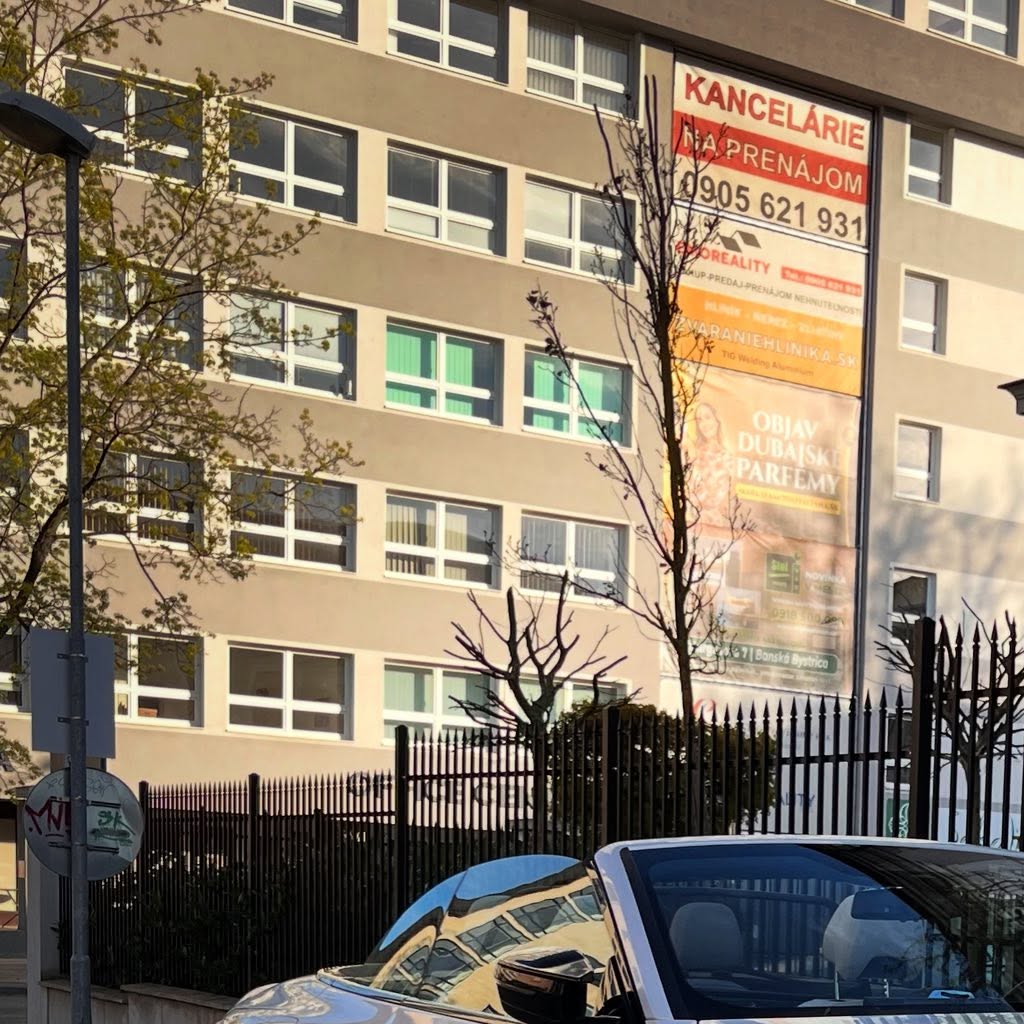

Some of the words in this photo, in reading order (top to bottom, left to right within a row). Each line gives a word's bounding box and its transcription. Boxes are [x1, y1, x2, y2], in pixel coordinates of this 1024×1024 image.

[685, 72, 864, 150] KANCELÁRIE
[727, 141, 862, 195] PRENÁJOM
[683, 171, 750, 212] 0905
[760, 192, 804, 227] 621
[818, 207, 862, 241] 931
[752, 410, 819, 440] OBJAV
[791, 652, 829, 670] Bystrica
